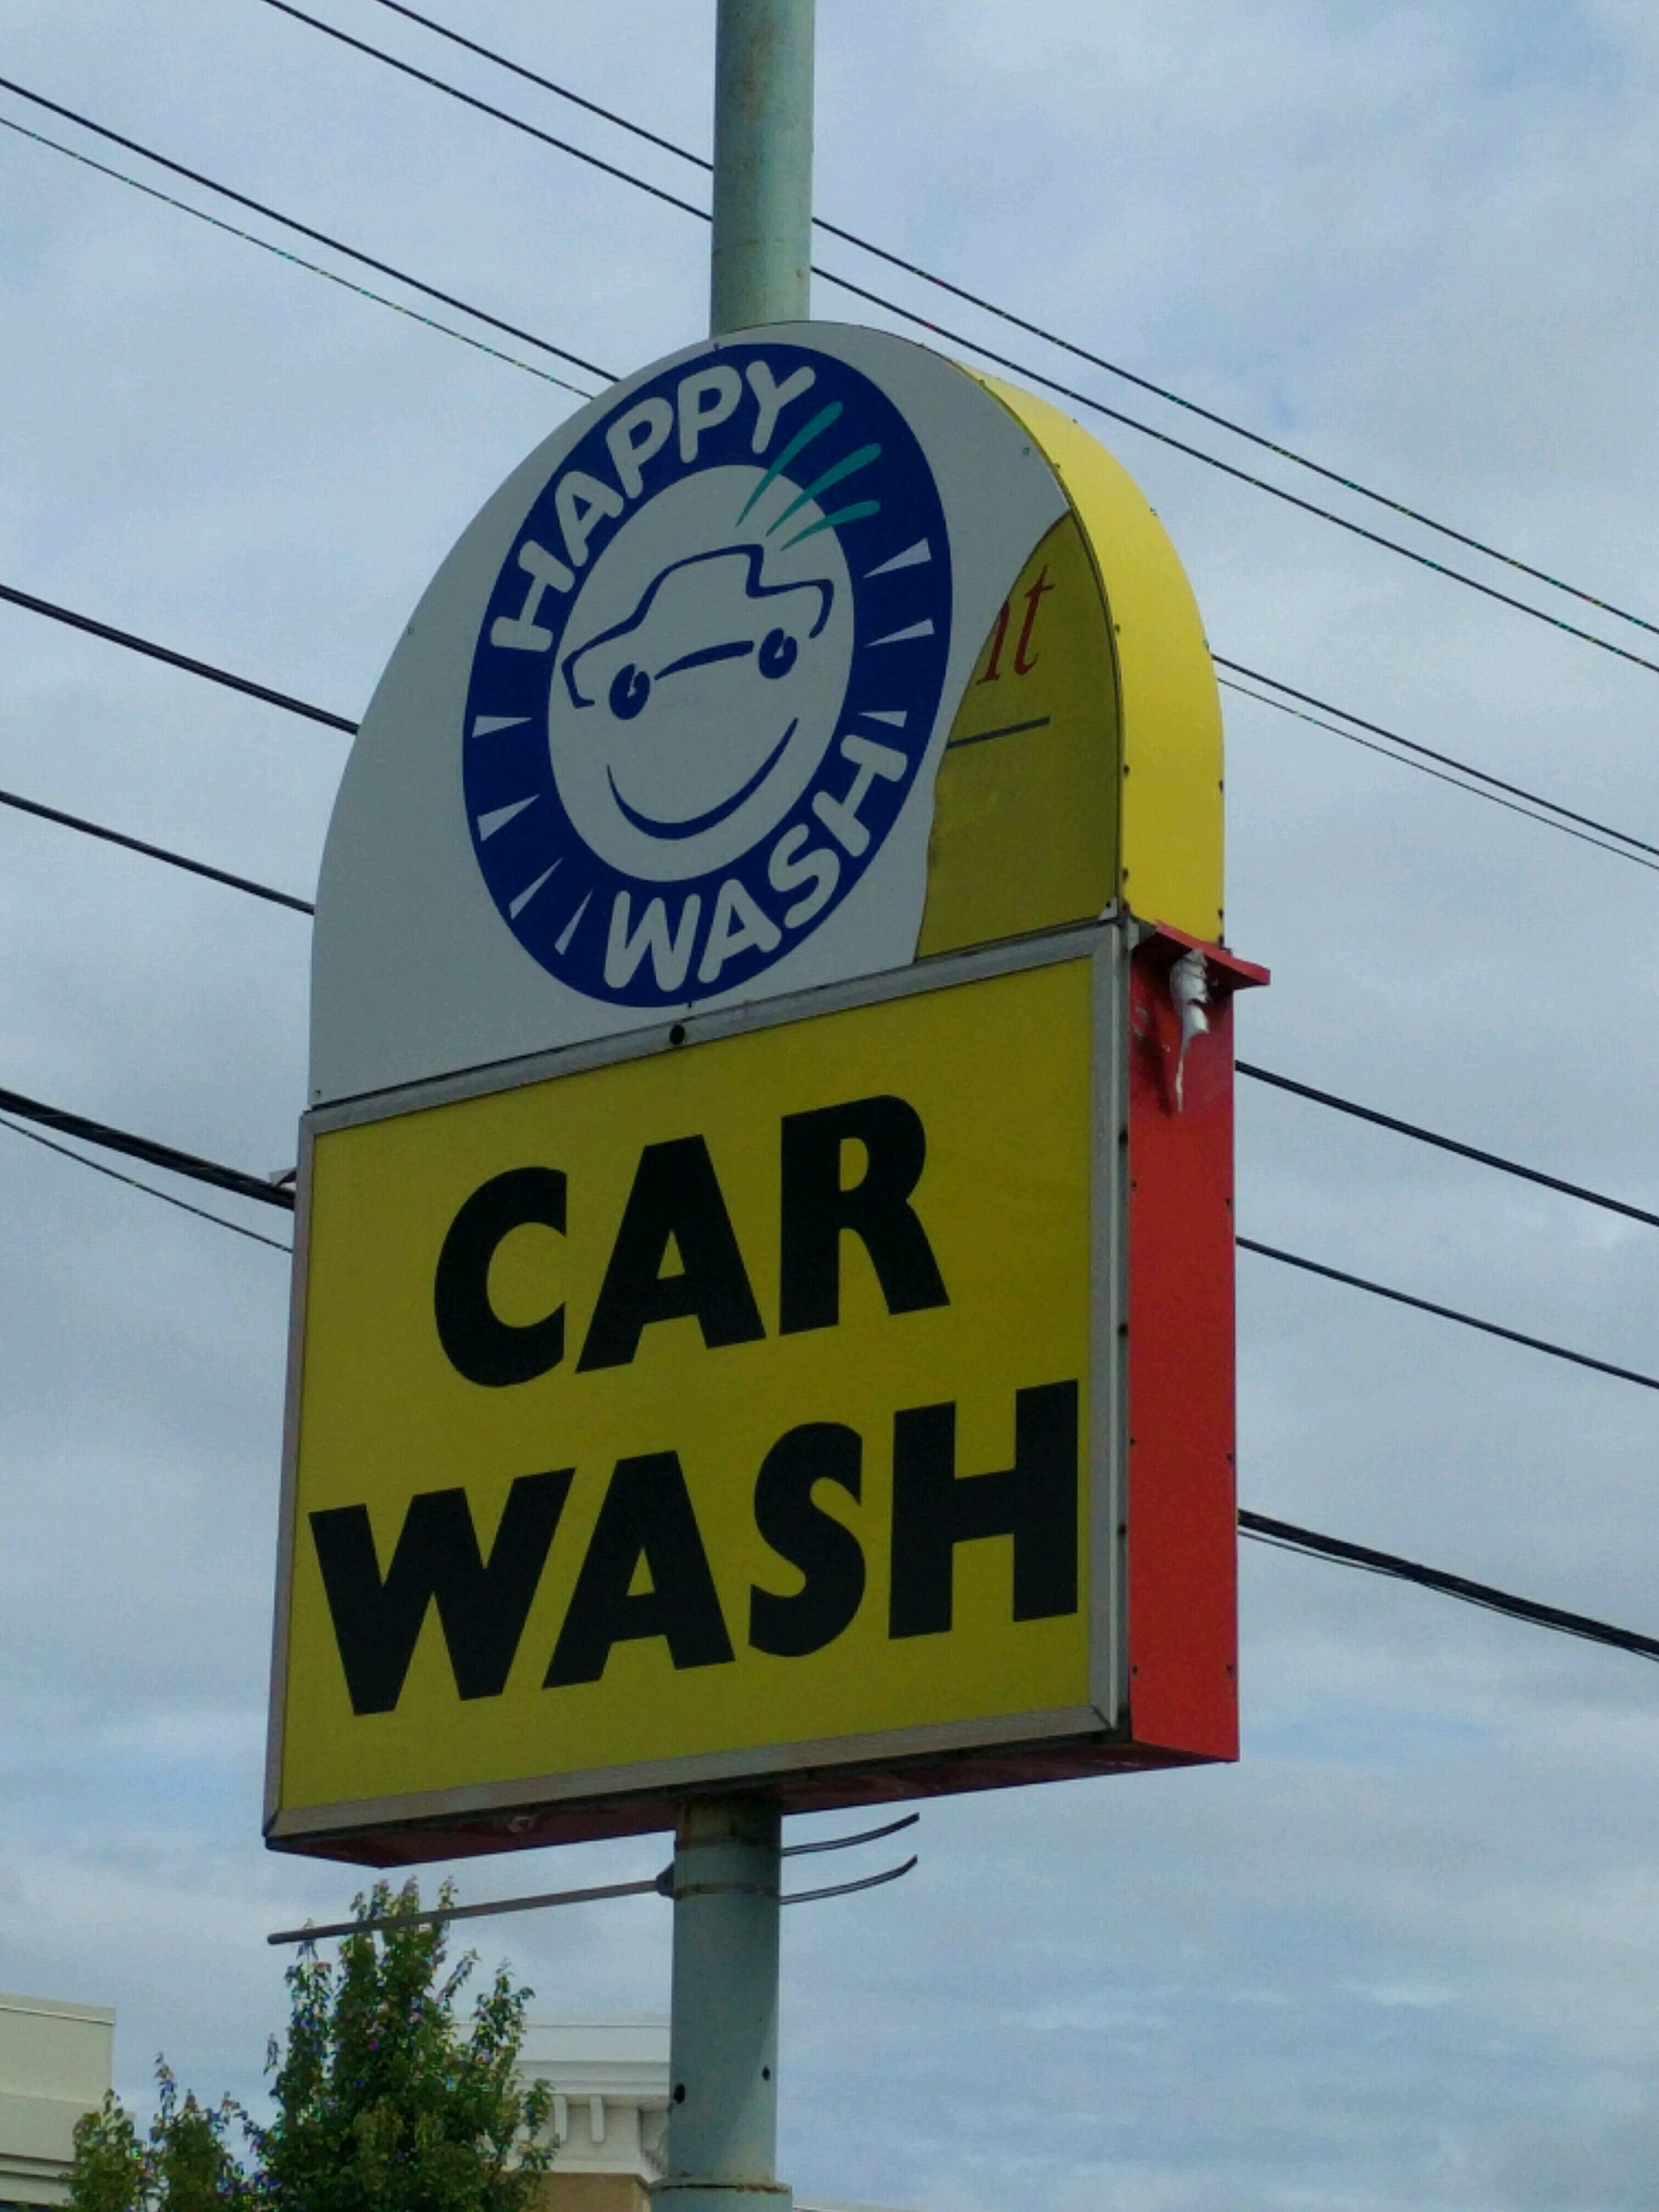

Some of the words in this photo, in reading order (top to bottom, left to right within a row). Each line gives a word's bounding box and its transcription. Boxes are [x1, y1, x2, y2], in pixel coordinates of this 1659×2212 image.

[490, 360, 816, 653] HAPPY
[603, 733, 909, 989] WASH
[433, 1094, 951, 1388] CAR
[308, 1378, 1079, 1717] WASH
